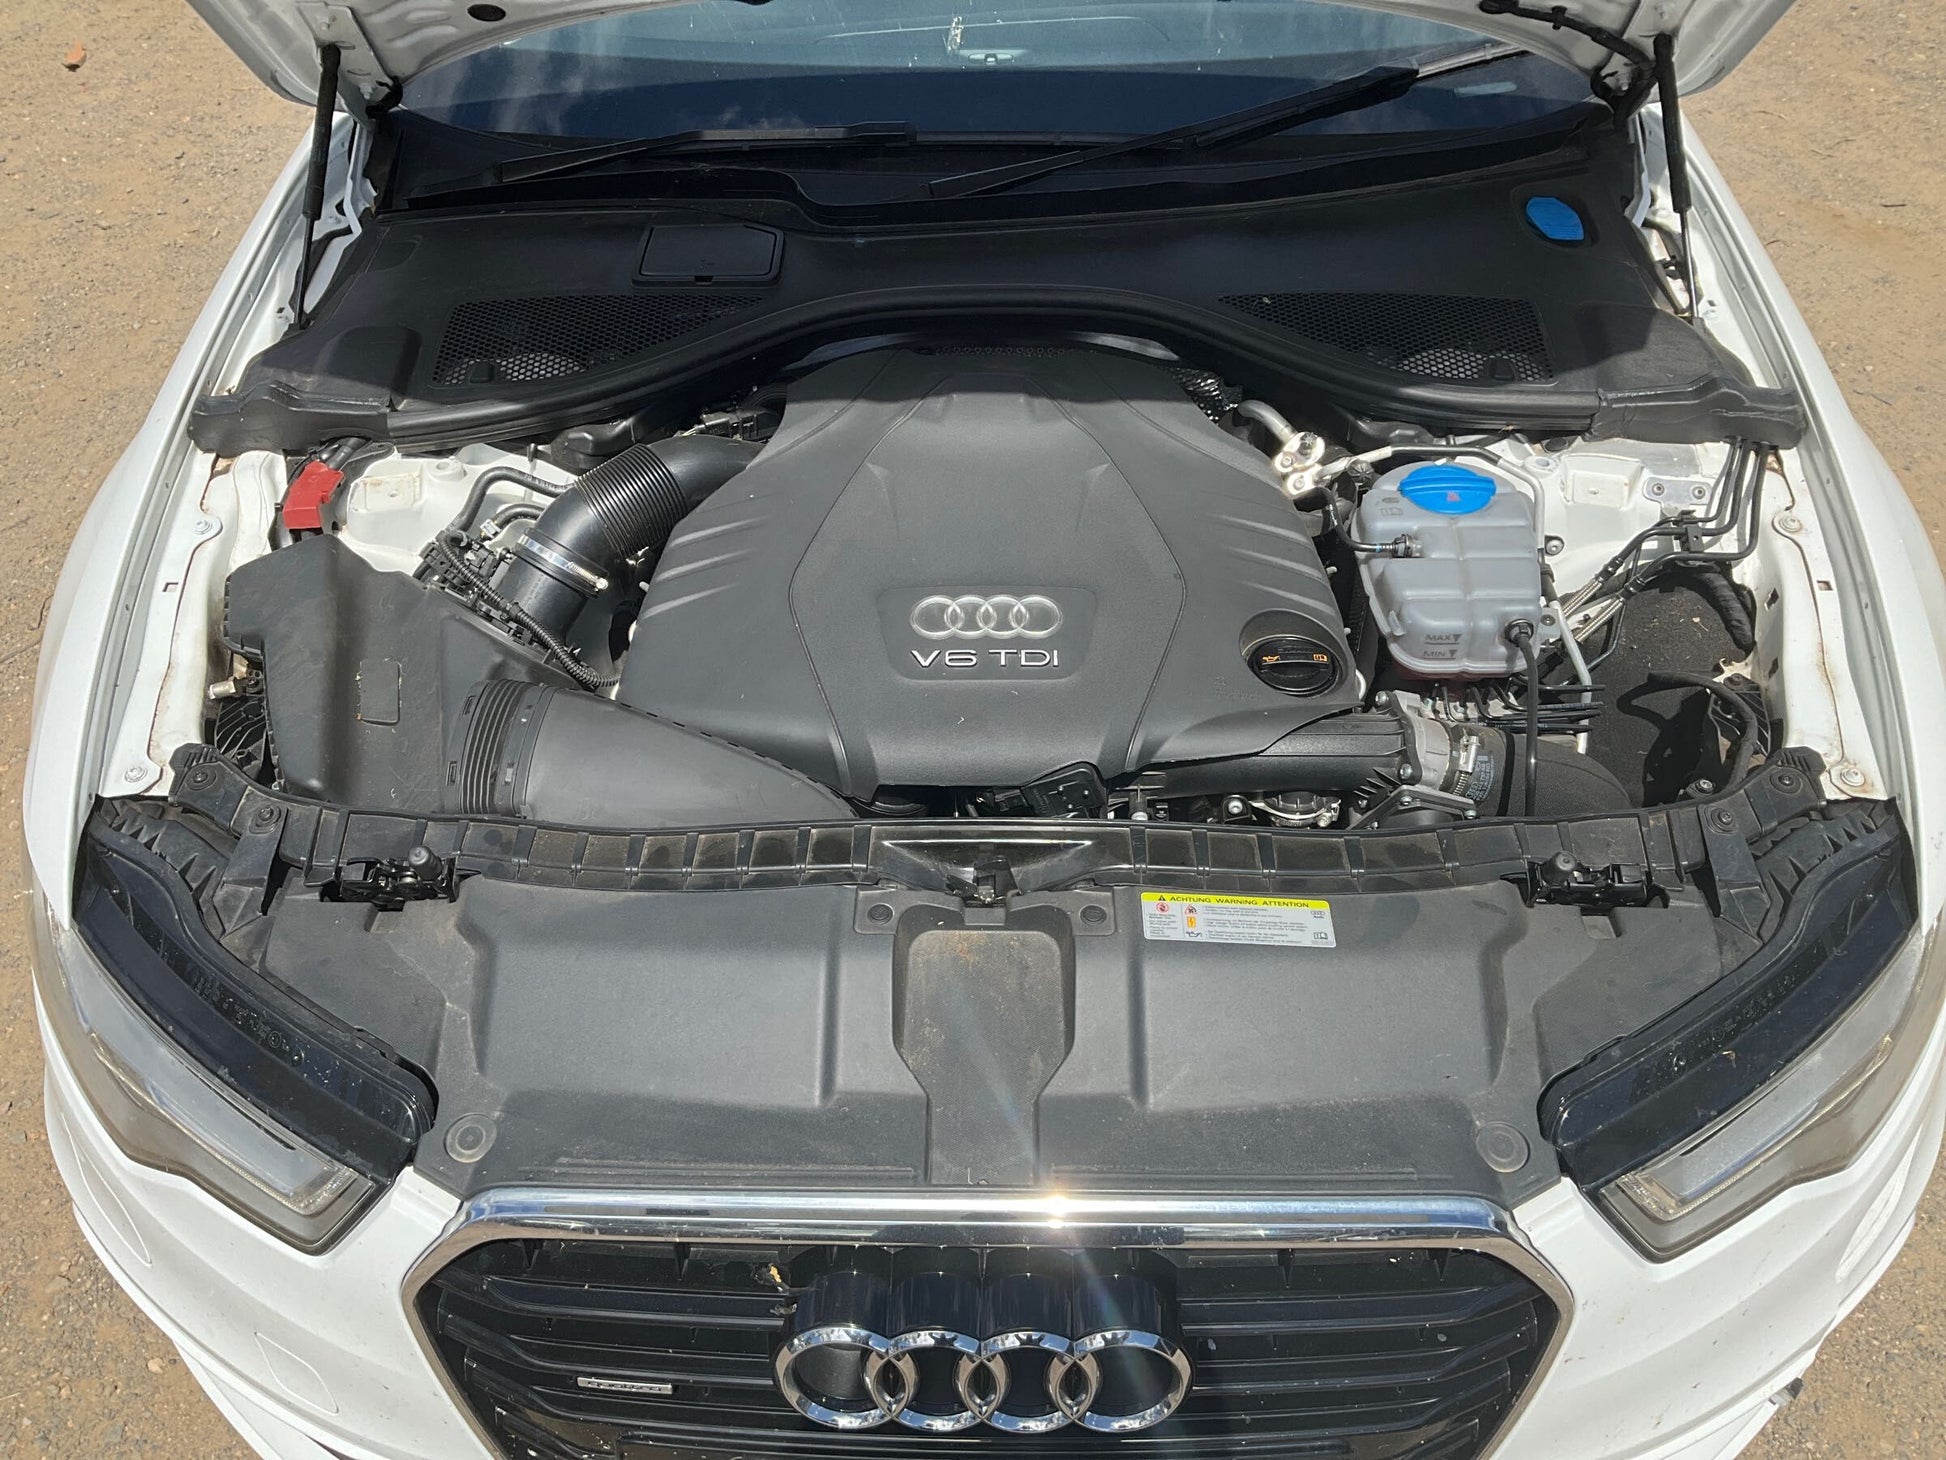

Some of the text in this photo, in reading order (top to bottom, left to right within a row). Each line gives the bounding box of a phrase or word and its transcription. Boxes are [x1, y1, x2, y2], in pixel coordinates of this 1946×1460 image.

[1424, 633, 1450, 641] MAX
[911, 649, 1059, 667] V6 TDI
[1169, 895, 1310, 908] ACHTUNG WARNING ATTENTION
